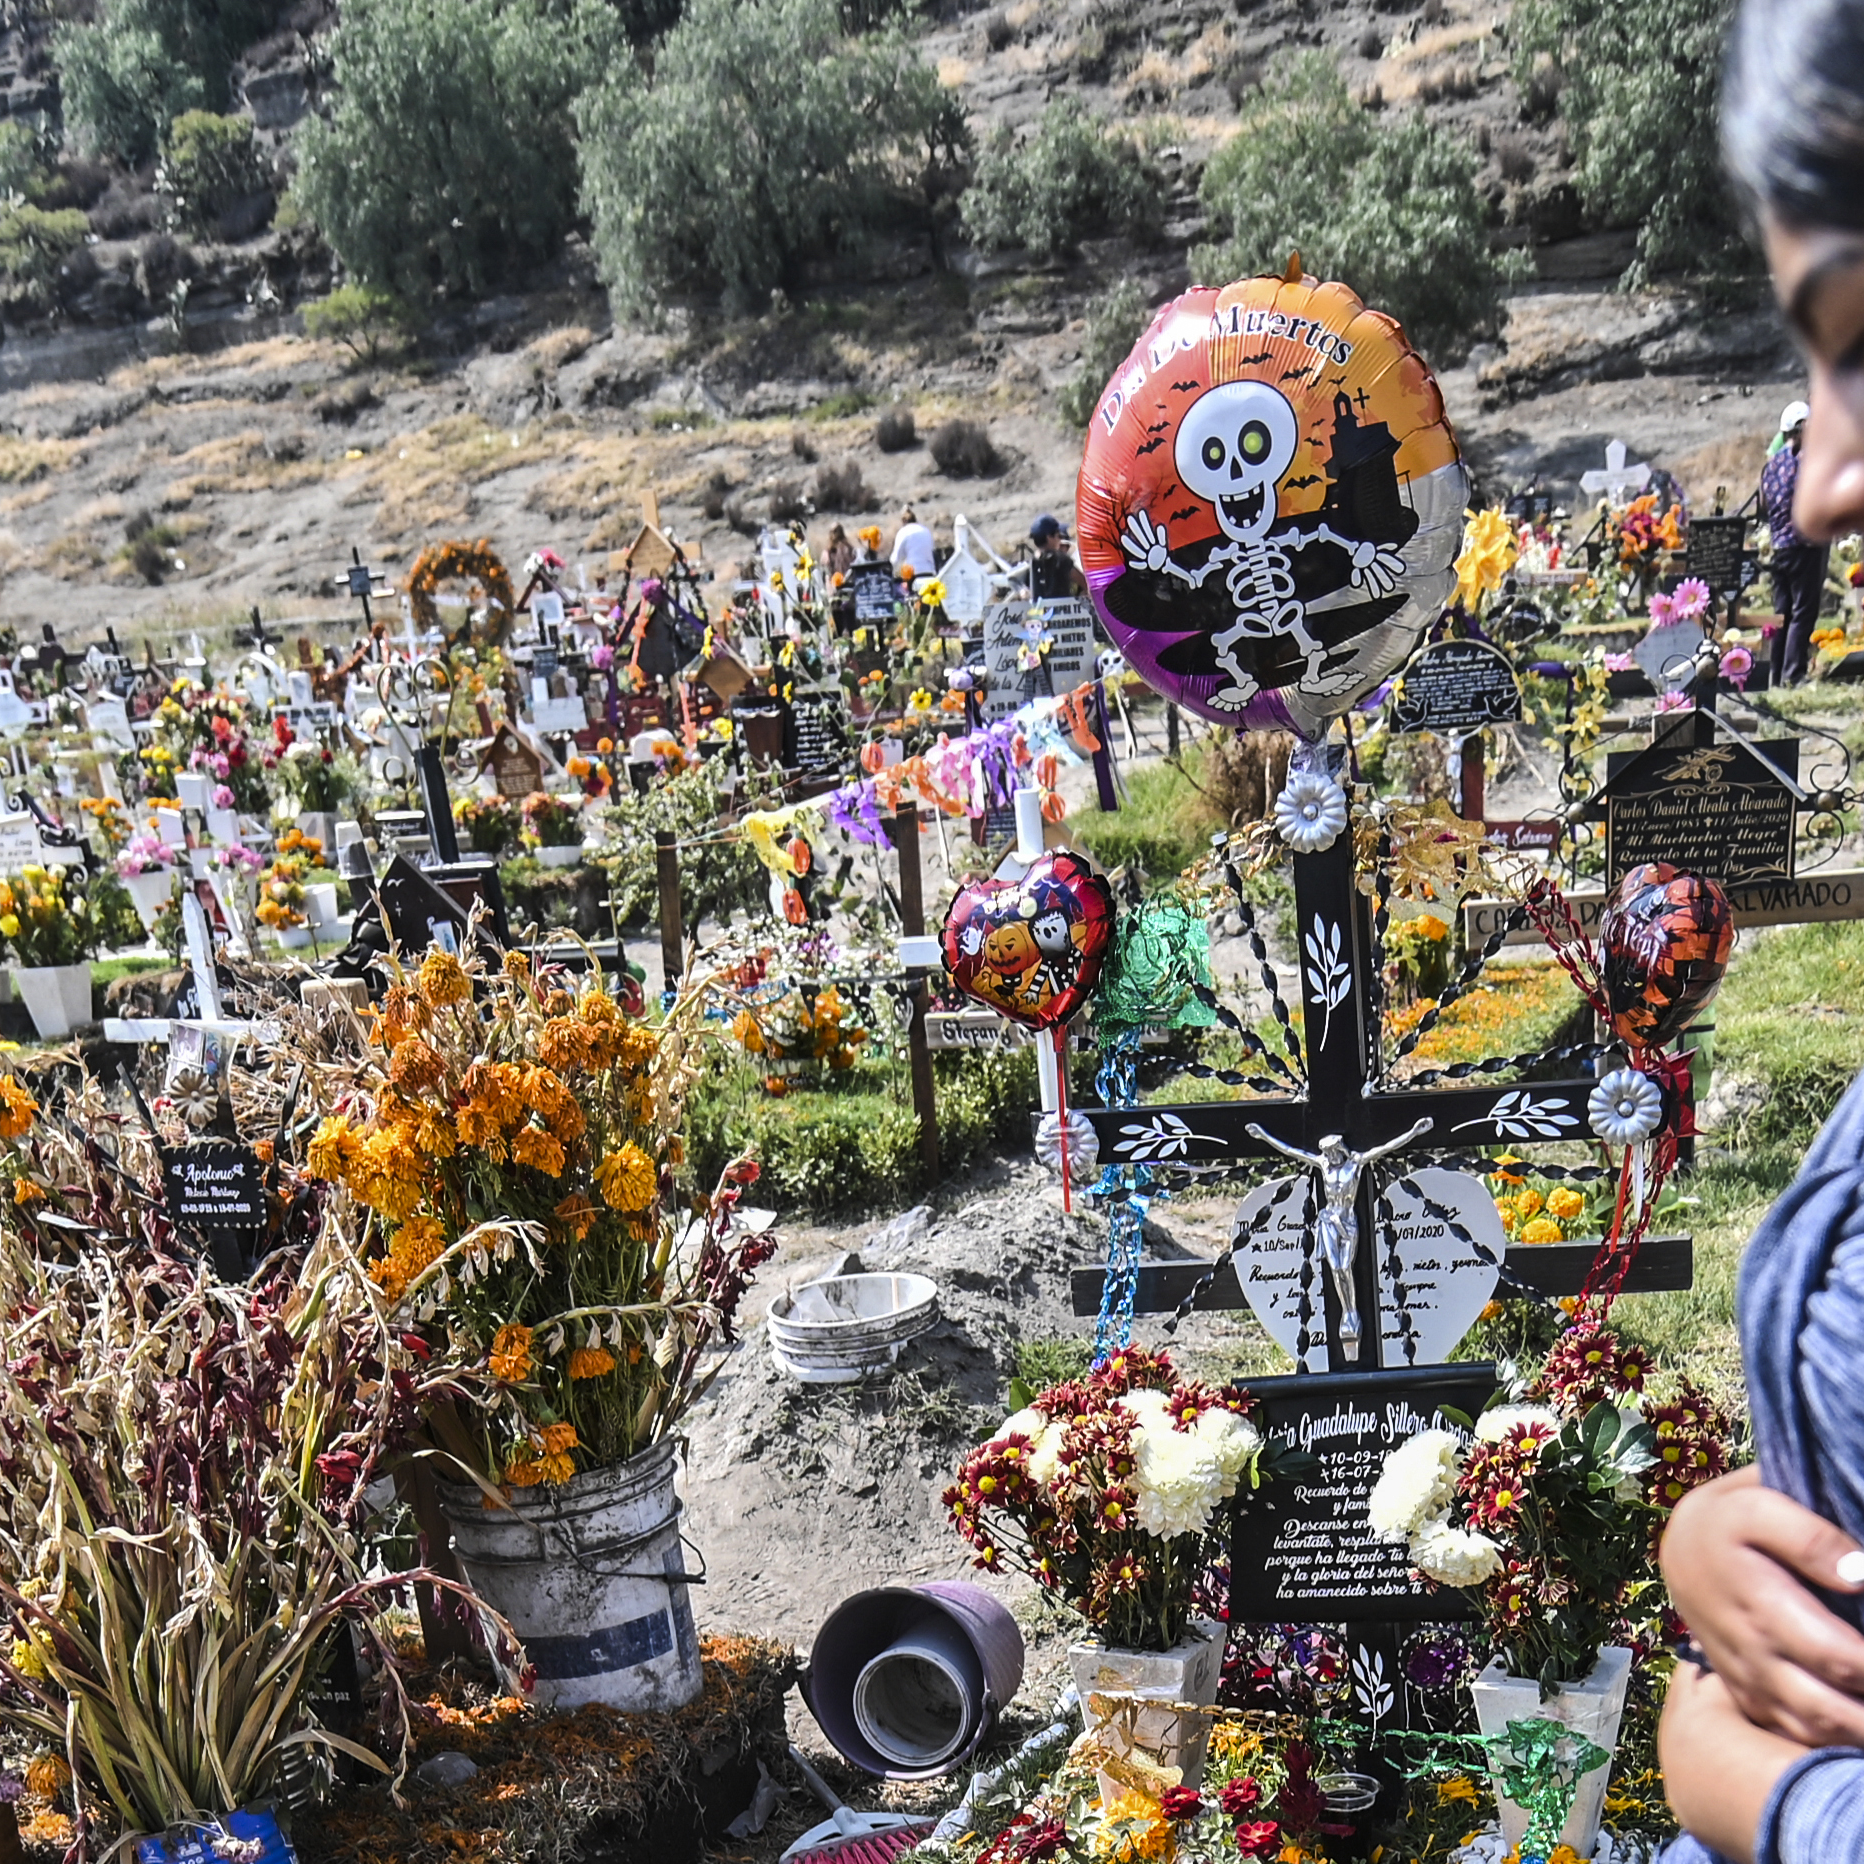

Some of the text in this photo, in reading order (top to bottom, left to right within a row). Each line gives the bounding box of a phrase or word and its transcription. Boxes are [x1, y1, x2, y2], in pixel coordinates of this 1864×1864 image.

[1210, 301, 1354, 366] Muertos
[1614, 801, 1646, 819] Carlos
[1651, 798, 1688, 817] Daniel
[1733, 792, 1788, 811] Alvarado
[1684, 847, 1699, 858] de
[1703, 847, 1718, 857] tu
[1722, 843, 1784, 857] Familia
[1299, 1401, 1378, 1453] Guadalupe
[1294, 1482, 1368, 1504] Recuerdo de
[1333, 1501, 1341, 1516] y
[1284, 1518, 1367, 1539] Descanse en
[1265, 1548, 1404, 1571] porque ha llegado tu
[1281, 1572, 1291, 1586] y
[1294, 1567, 1308, 1581] la
[1311, 1566, 1351, 1586] gloria
[1354, 1565, 1375, 1579] del
[1276, 1581, 1422, 1599] ha amanecido sobre ti
